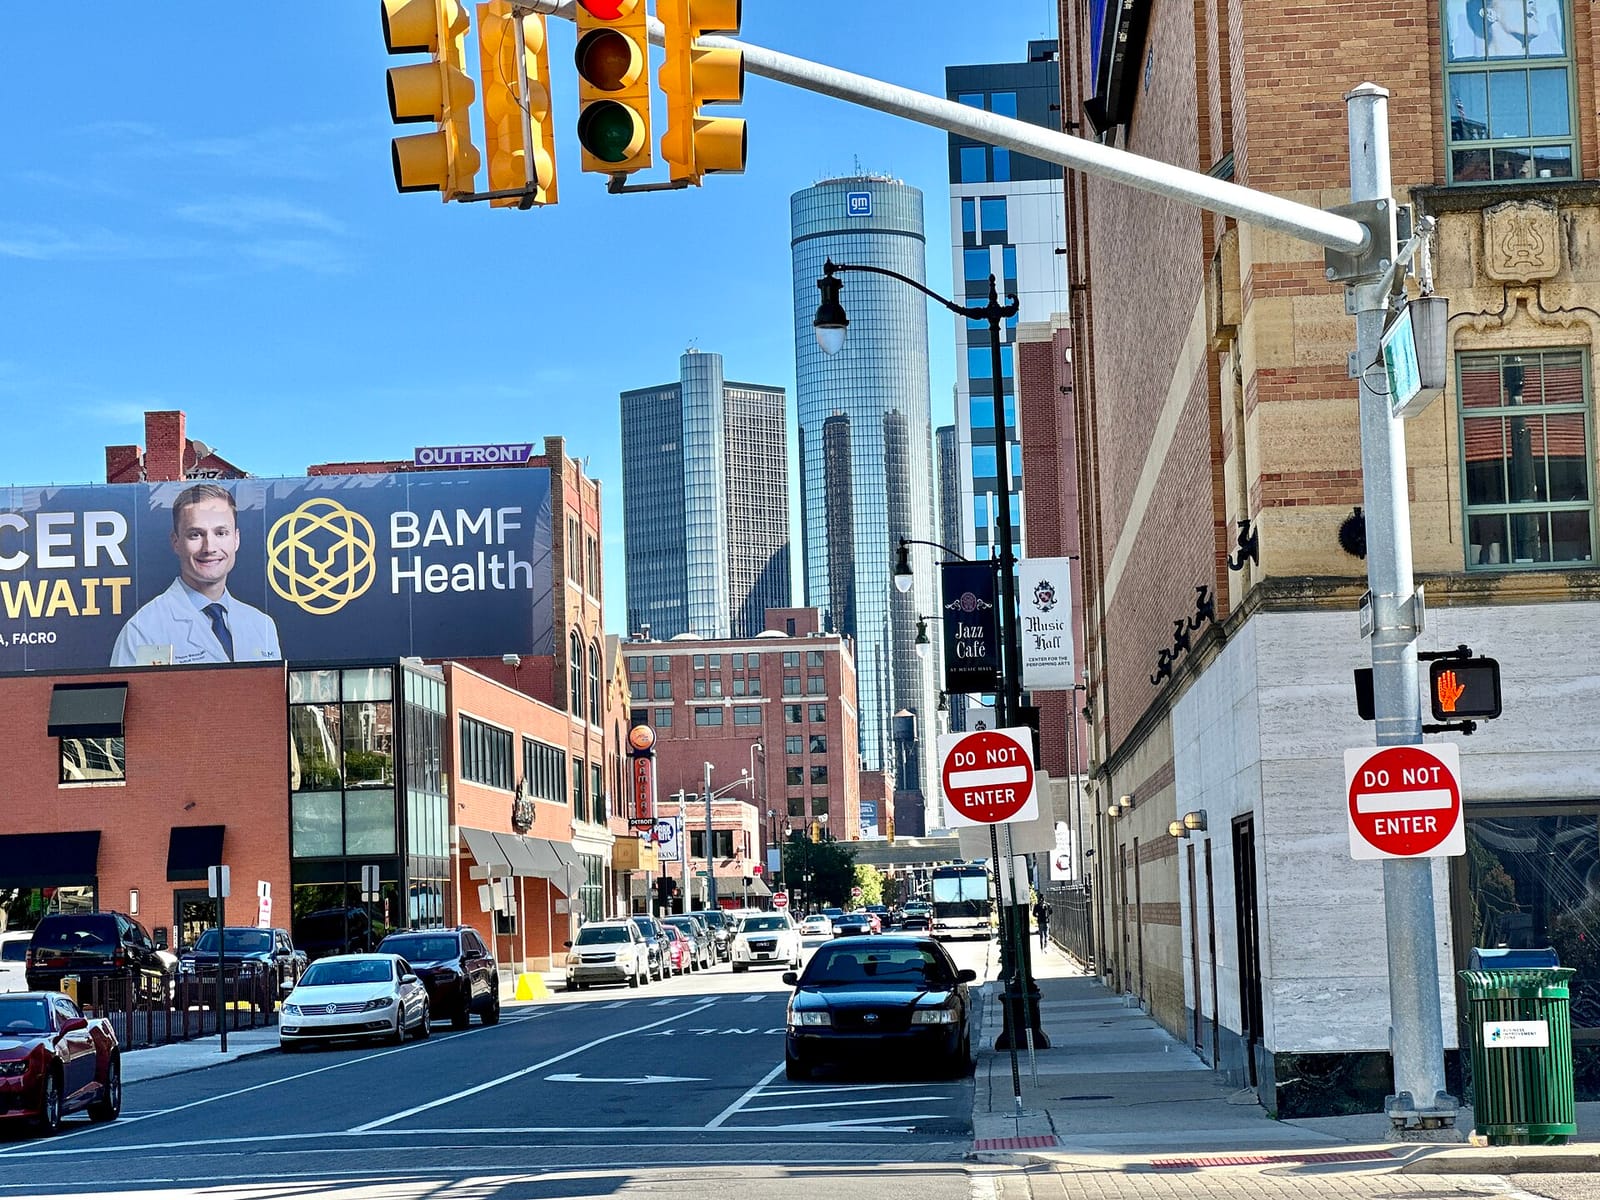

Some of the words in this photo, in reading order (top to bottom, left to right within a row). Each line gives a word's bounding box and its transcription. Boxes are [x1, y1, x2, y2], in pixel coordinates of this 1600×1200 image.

[851, 197, 868, 210] gm
[418, 445, 527, 465] OUTFRONT
[390, 506, 522, 549] BAMF
[0, 510, 129, 571] CER
[391, 550, 534, 594] Health
[0, 577, 131, 619] WAIT
[955, 621, 984, 640] Jazz
[1025, 616, 1064, 632] Music
[12, 631, 57, 645] FACRO
[1032, 633, 1062, 651] Hall
[956, 640, 986, 659] Café
[954, 751, 976, 767] DO
[986, 747, 1017, 764] NOT
[1363, 769, 1390, 788] DO
[1402, 766, 1441, 785] NOT
[964, 788, 1016, 807] ENTER
[1374, 815, 1438, 836] ENTER
